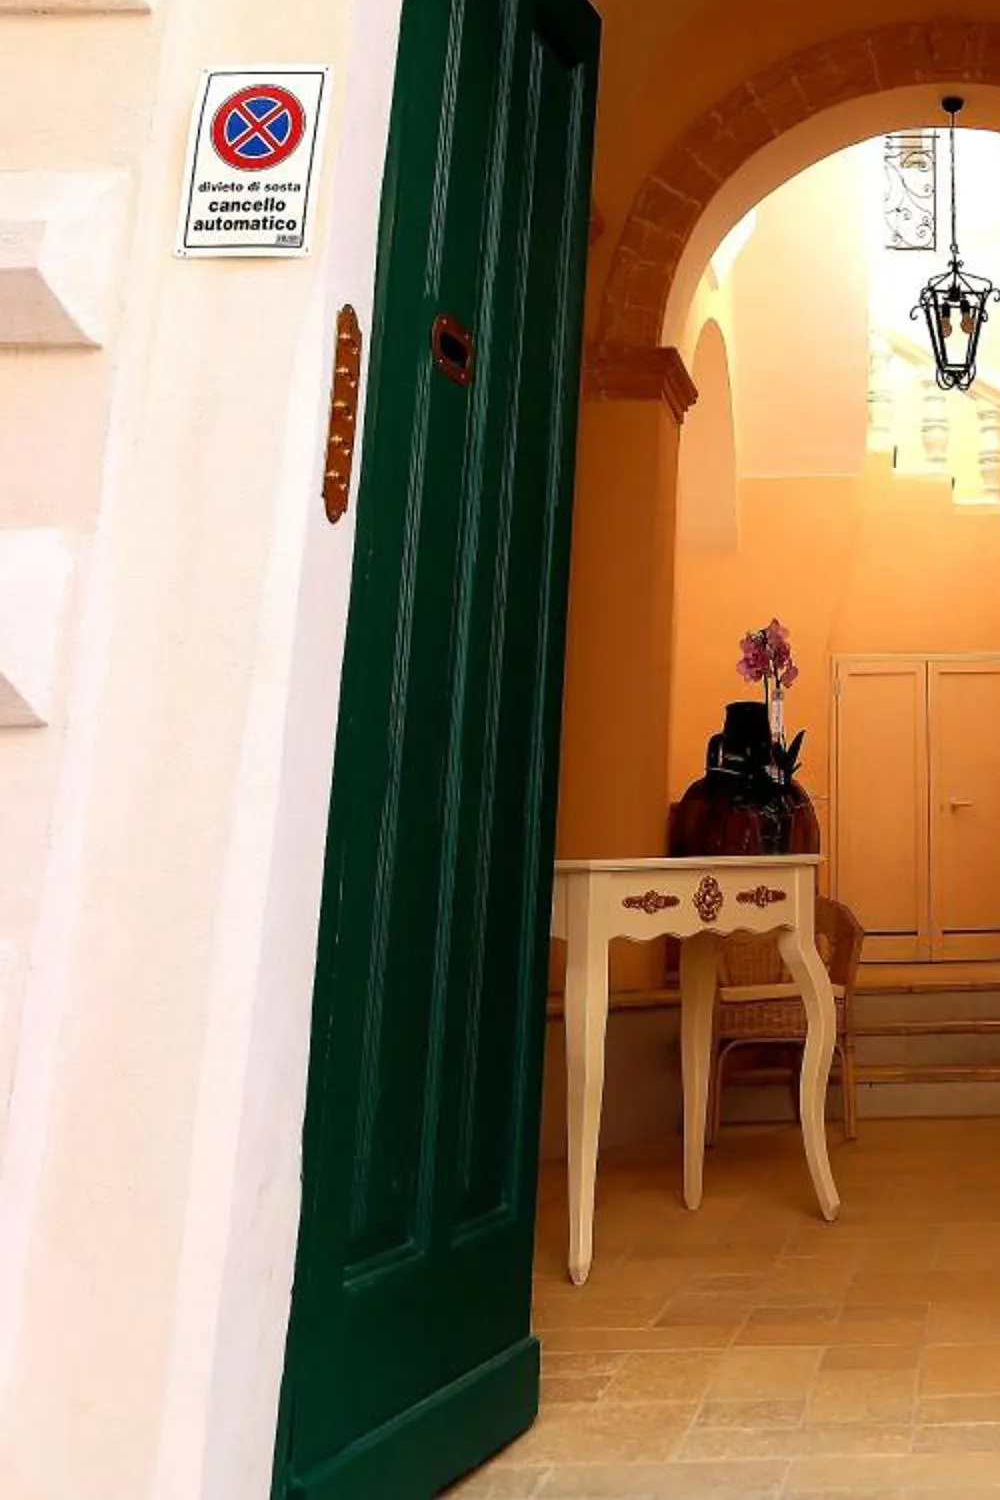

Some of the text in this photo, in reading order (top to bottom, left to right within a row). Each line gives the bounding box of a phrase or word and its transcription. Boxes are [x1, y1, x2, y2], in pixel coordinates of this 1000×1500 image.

[198, 181, 301, 192] divieto di sosta
[208, 197, 286, 212] cancello
[193, 215, 297, 231] automatico
